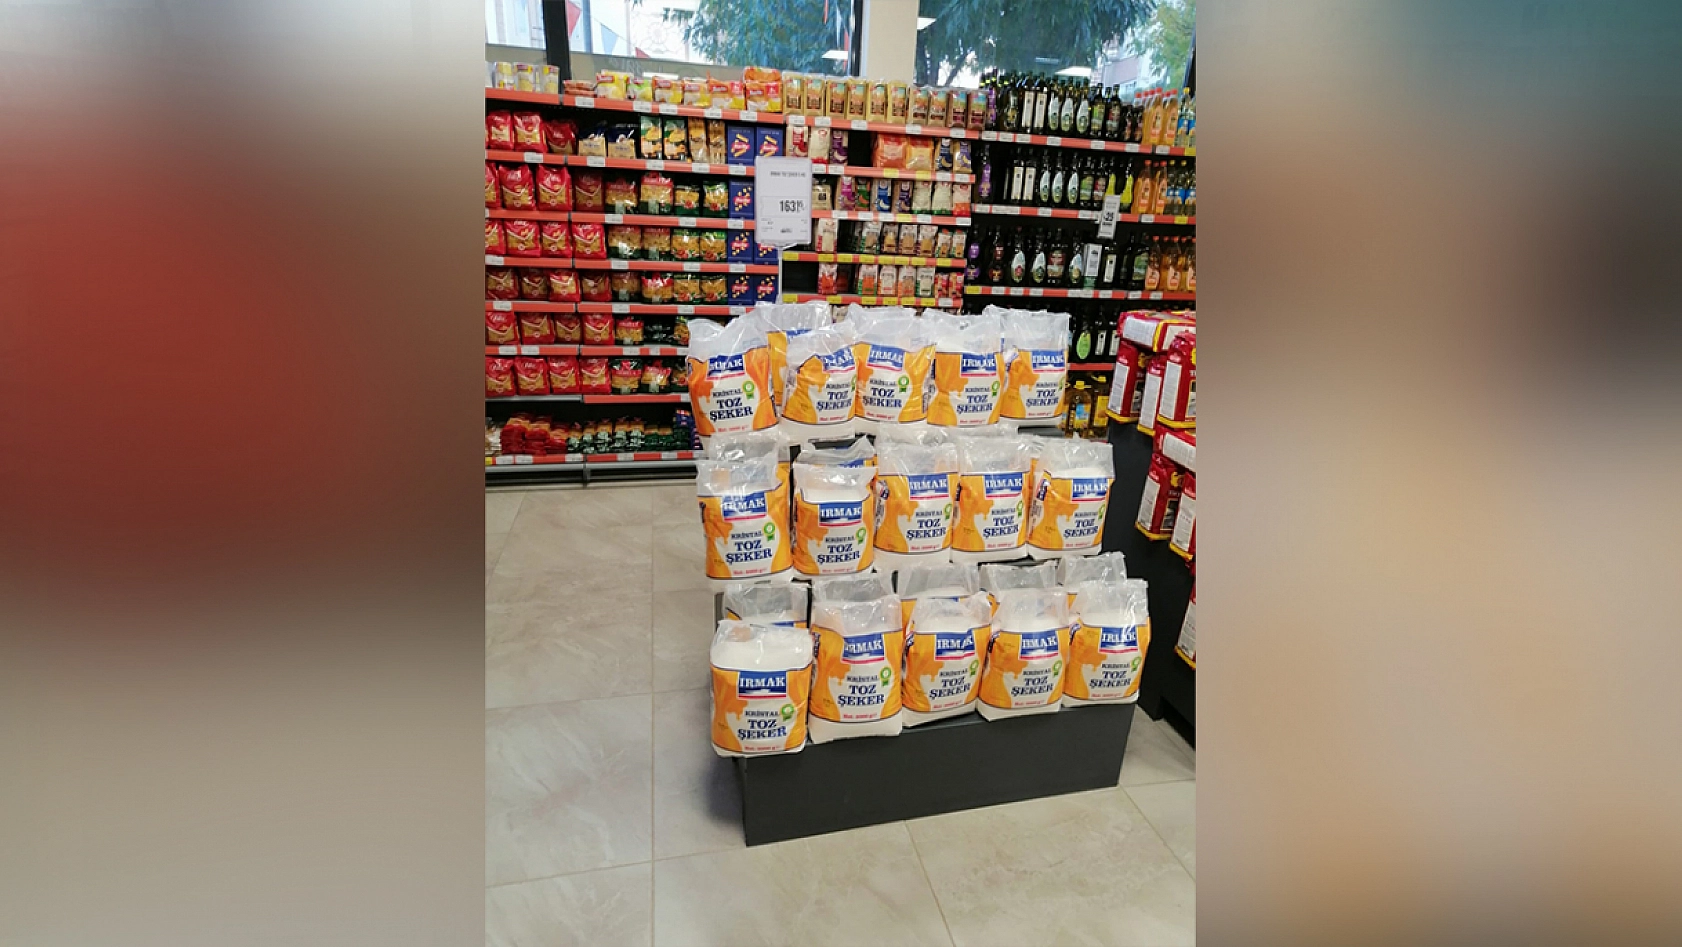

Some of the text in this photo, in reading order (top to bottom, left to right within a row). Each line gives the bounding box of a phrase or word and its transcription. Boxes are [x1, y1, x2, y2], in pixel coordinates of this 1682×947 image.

[826, 390, 848, 401] TOZ
[870, 387, 895, 397] TOZ
[1035, 389, 1056, 398] TOZ
[716, 397, 743, 409] TOZ
[816, 398, 852, 412] ŞEKER
[862, 395, 902, 408] ŞEKER
[966, 394, 989, 404] TOZ
[1025, 397, 1059, 408] ŞEKER
[709, 406, 753, 422] ŞEKER
[956, 403, 993, 414] ŞEKER
[909, 478, 948, 490] IRMAK
[985, 478, 1022, 488] IRMAK
[820, 507, 861, 518] IRMAK
[916, 518, 941, 528] TOZ
[992, 515, 1015, 527] TOZ
[1074, 518, 1095, 528] TOZ
[906, 527, 947, 541] ŞEKER
[982, 524, 1019, 539] ŞEKER
[1063, 526, 1099, 539] ŞEKER
[733, 539, 762, 551] TOZ
[826, 543, 853, 554] TOZ
[725, 548, 773, 566] ŞEKER
[817, 550, 861, 565] ŞEKER
[844, 640, 883, 654] IRMAK
[937, 634, 973, 650] IRMAK
[1101, 669, 1128, 679] TOZ
[740, 677, 786, 688] IRMAK
[940, 676, 966, 688] TOZ
[1023, 676, 1049, 687] TOZ
[1089, 678, 1132, 689] ŞEKER
[848, 684, 877, 695] TOZ
[929, 682, 971, 701] ŞEKER
[1010, 683, 1055, 697] ŞEKER
[837, 693, 885, 708] ŞEKER
[746, 718, 777, 730] TOZ
[737, 725, 787, 741] ŞEKER
